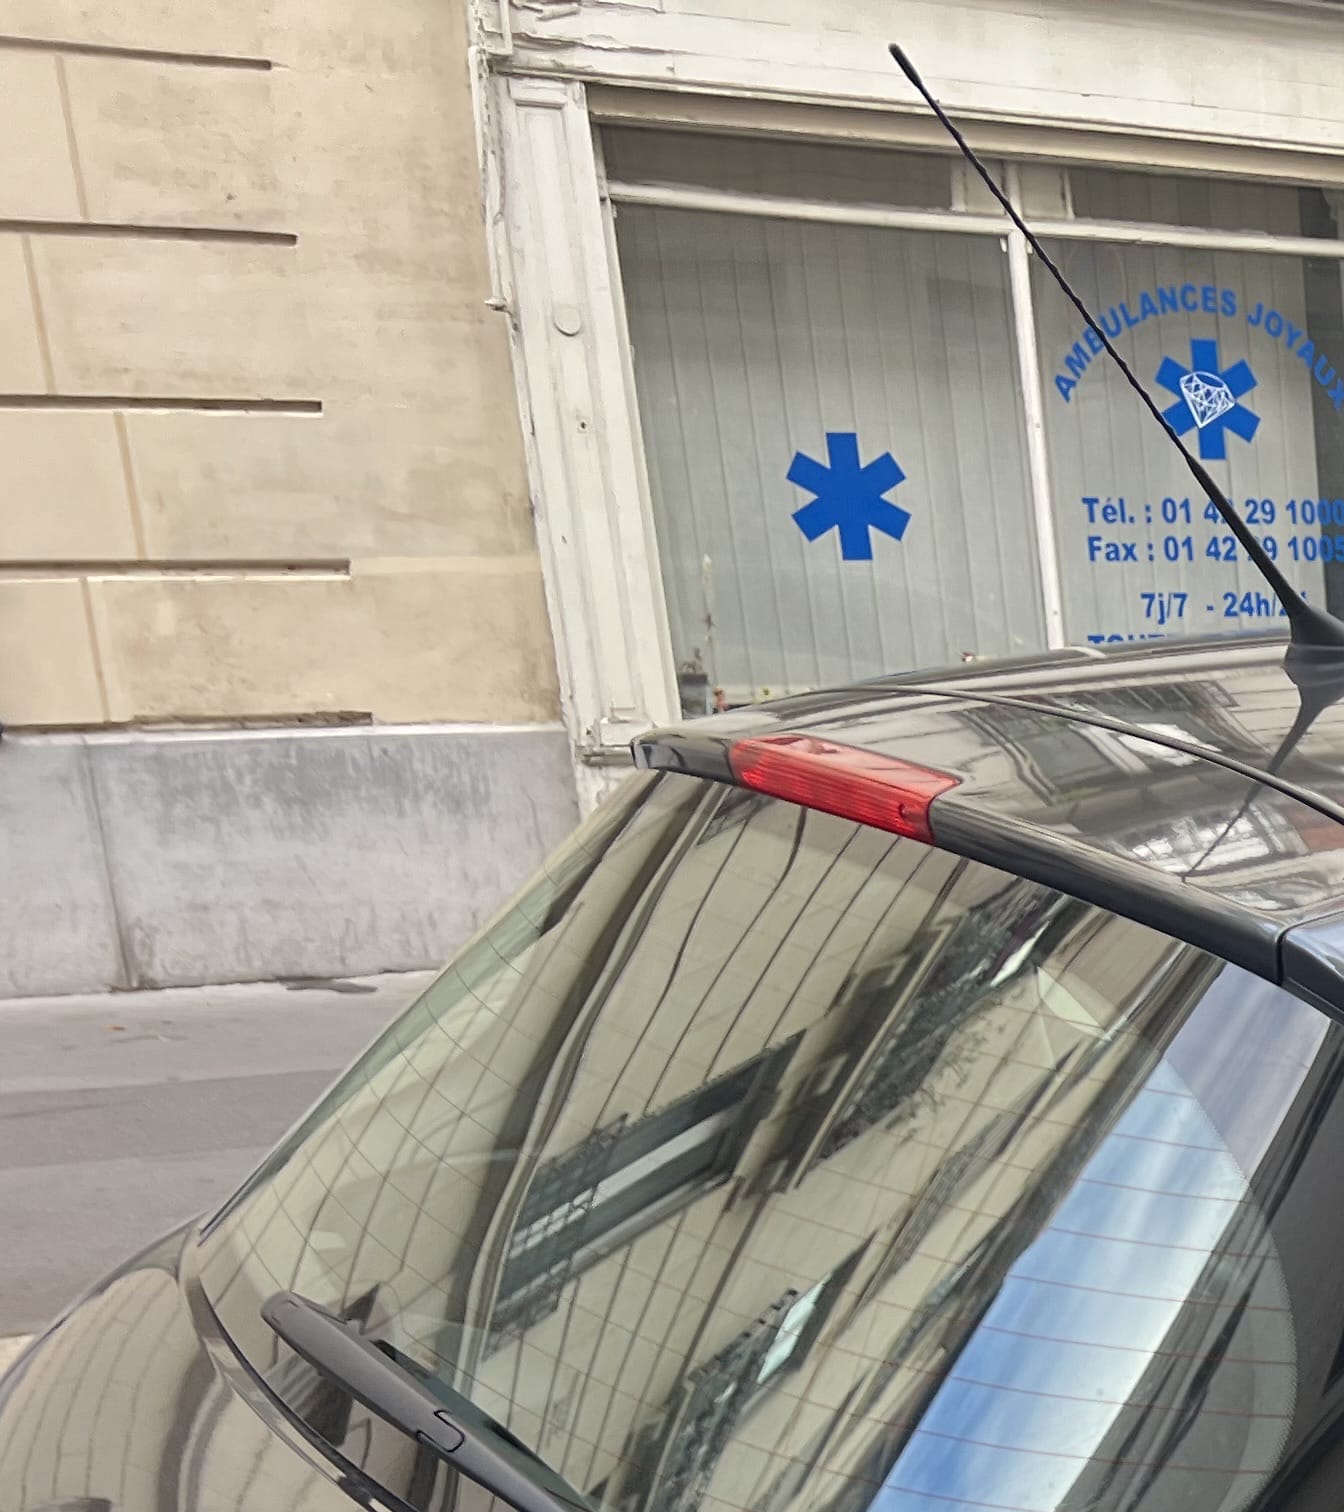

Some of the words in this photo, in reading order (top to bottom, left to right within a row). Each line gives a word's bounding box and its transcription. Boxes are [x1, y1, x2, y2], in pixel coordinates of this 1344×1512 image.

[1055, 283, 1237, 403] AMBULANCES
[1082, 497, 1135, 523] Tél.
[1162, 499, 1192, 523] 01
[1203, 499, 1233, 524] 4
[1245, 499, 1276, 524] 29
[1087, 536, 1138, 562] Fax
[1164, 536, 1194, 562] 01
[1206, 536, 1238, 562] 42
[1247, 536, 1278, 562] 9
[1140, 592, 1188, 625] 7j/7
[1223, 590, 1307, 618] 24h/
